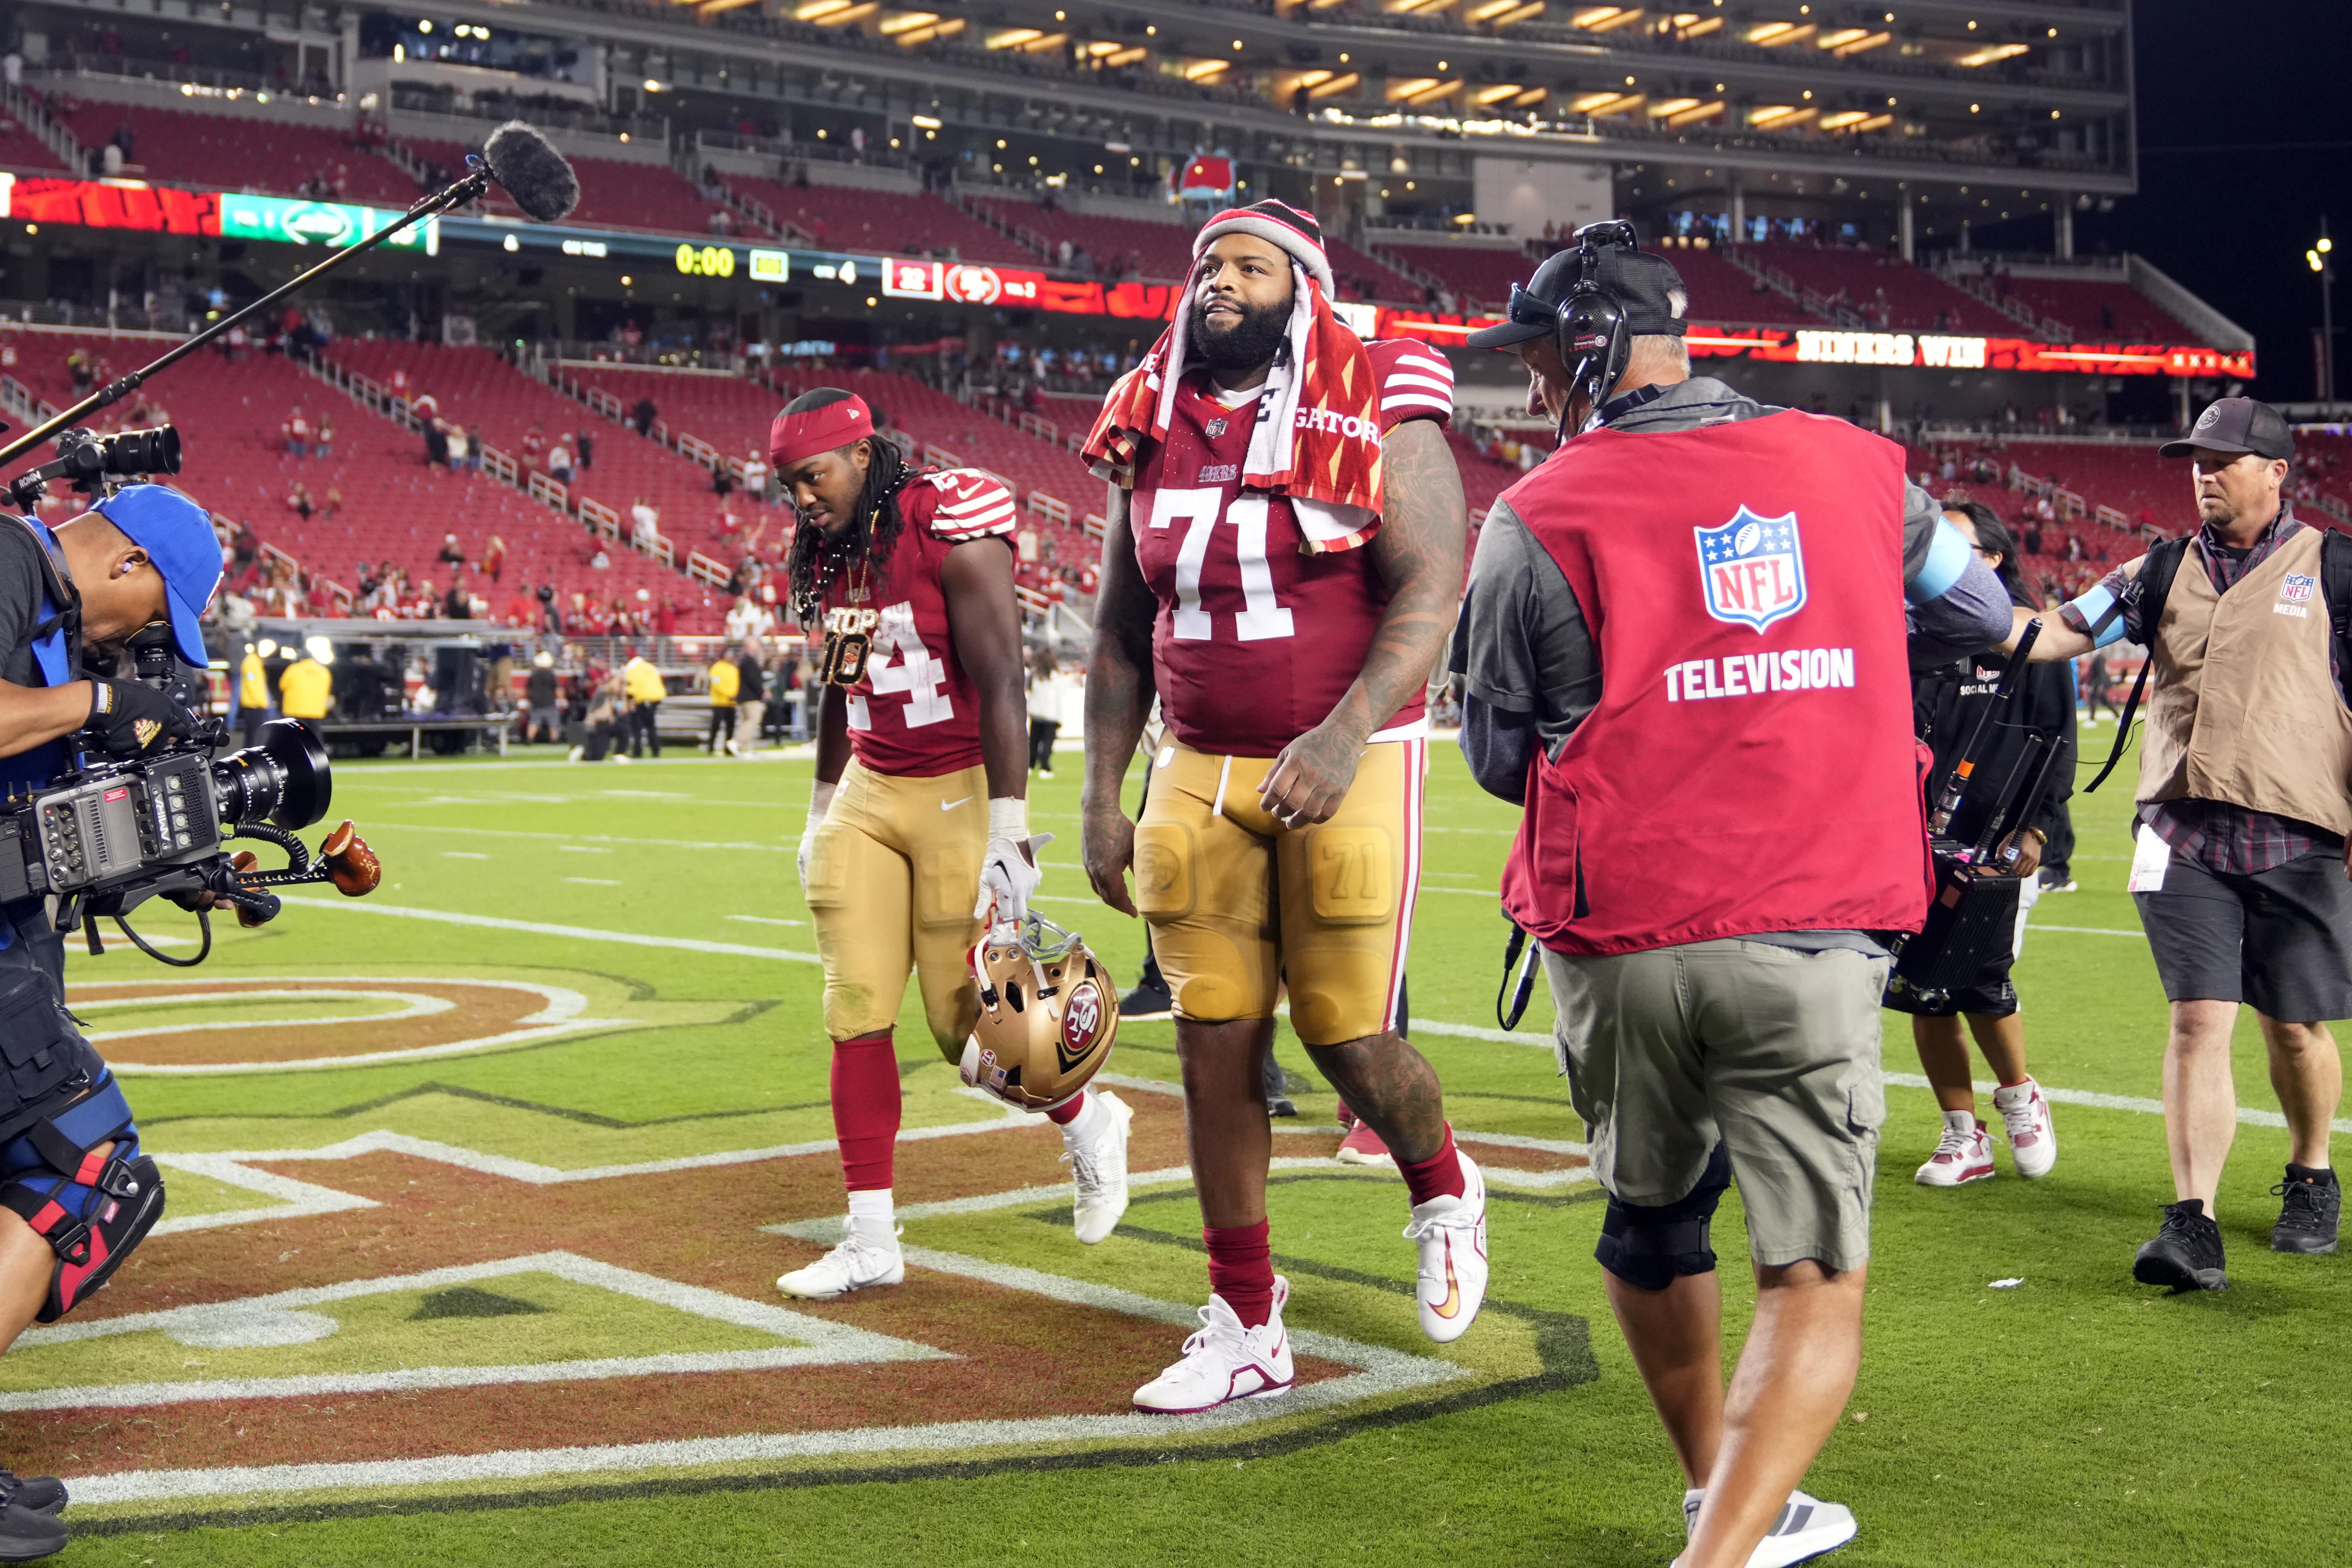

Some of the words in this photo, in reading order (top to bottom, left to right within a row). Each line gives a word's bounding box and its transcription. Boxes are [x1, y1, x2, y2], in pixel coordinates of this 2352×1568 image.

[676, 244, 734, 277] 0:00
[838, 260, 856, 285] 4
[1796, 330, 1914, 365] NINERS
[1919, 335, 1986, 368] WIN
[1208, 425, 1222, 437] NFL
[1295, 407, 1382, 445] GATOR
[19, 470, 41, 489] RONIN
[1199, 464, 1236, 482] 49ERS
[1149, 486, 1295, 641] 71
[1715, 559, 1793, 612] NFL
[2285, 585, 2307, 598] NFL
[829, 607, 879, 634] TOP
[2273, 603, 2307, 618] MEDIA
[819, 633, 872, 686] 10
[1663, 648, 1854, 702] TELEVISION
[1960, 684, 1988, 696] SOCIAL
[154, 793, 171, 841] AMIRA
[1323, 842, 1378, 899] 71
[1067, 1000, 1098, 1043] SF
